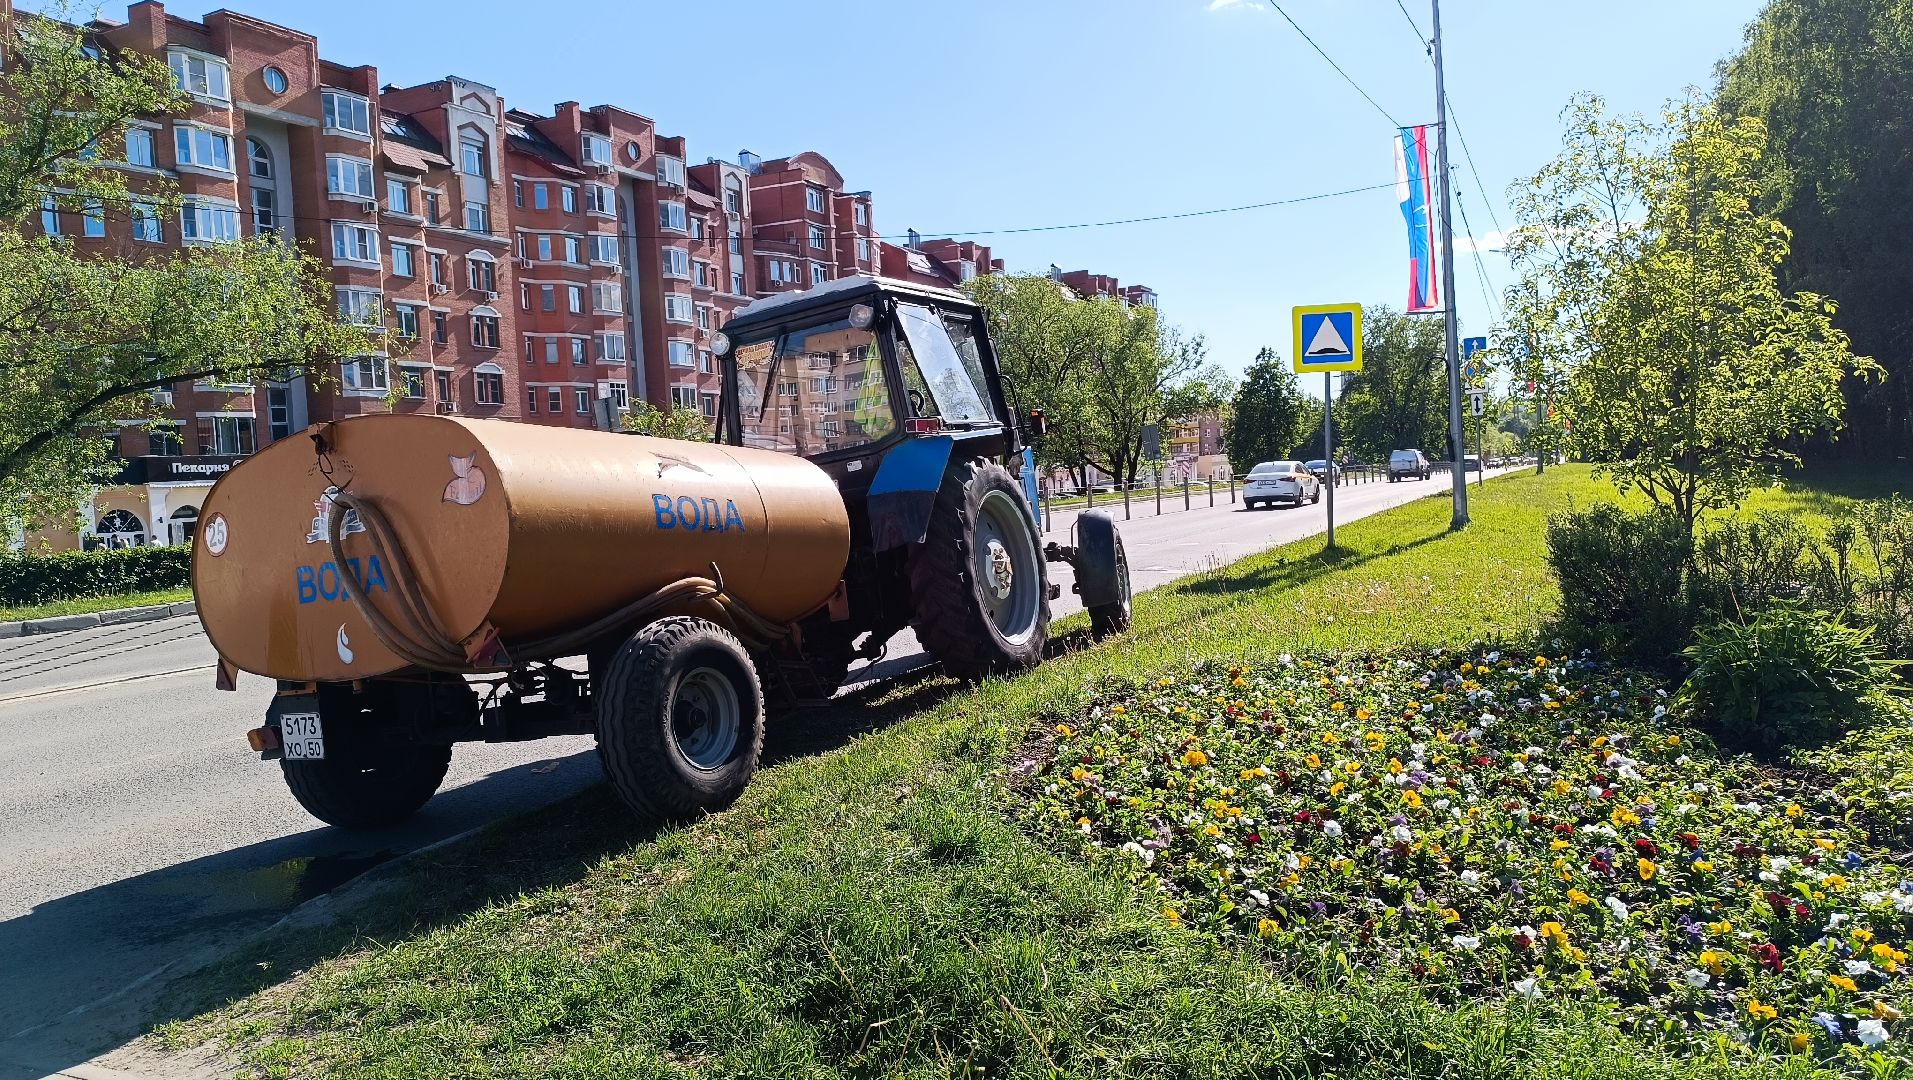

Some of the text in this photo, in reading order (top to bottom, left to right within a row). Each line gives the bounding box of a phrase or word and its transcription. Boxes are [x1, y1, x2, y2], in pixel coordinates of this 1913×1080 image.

[171, 462, 230, 476] Пекарня
[652, 493, 745, 533] ВОДА
[208, 521, 225, 547] 25
[285, 716, 317, 736] 5173
[307, 741, 321, 757] 50
